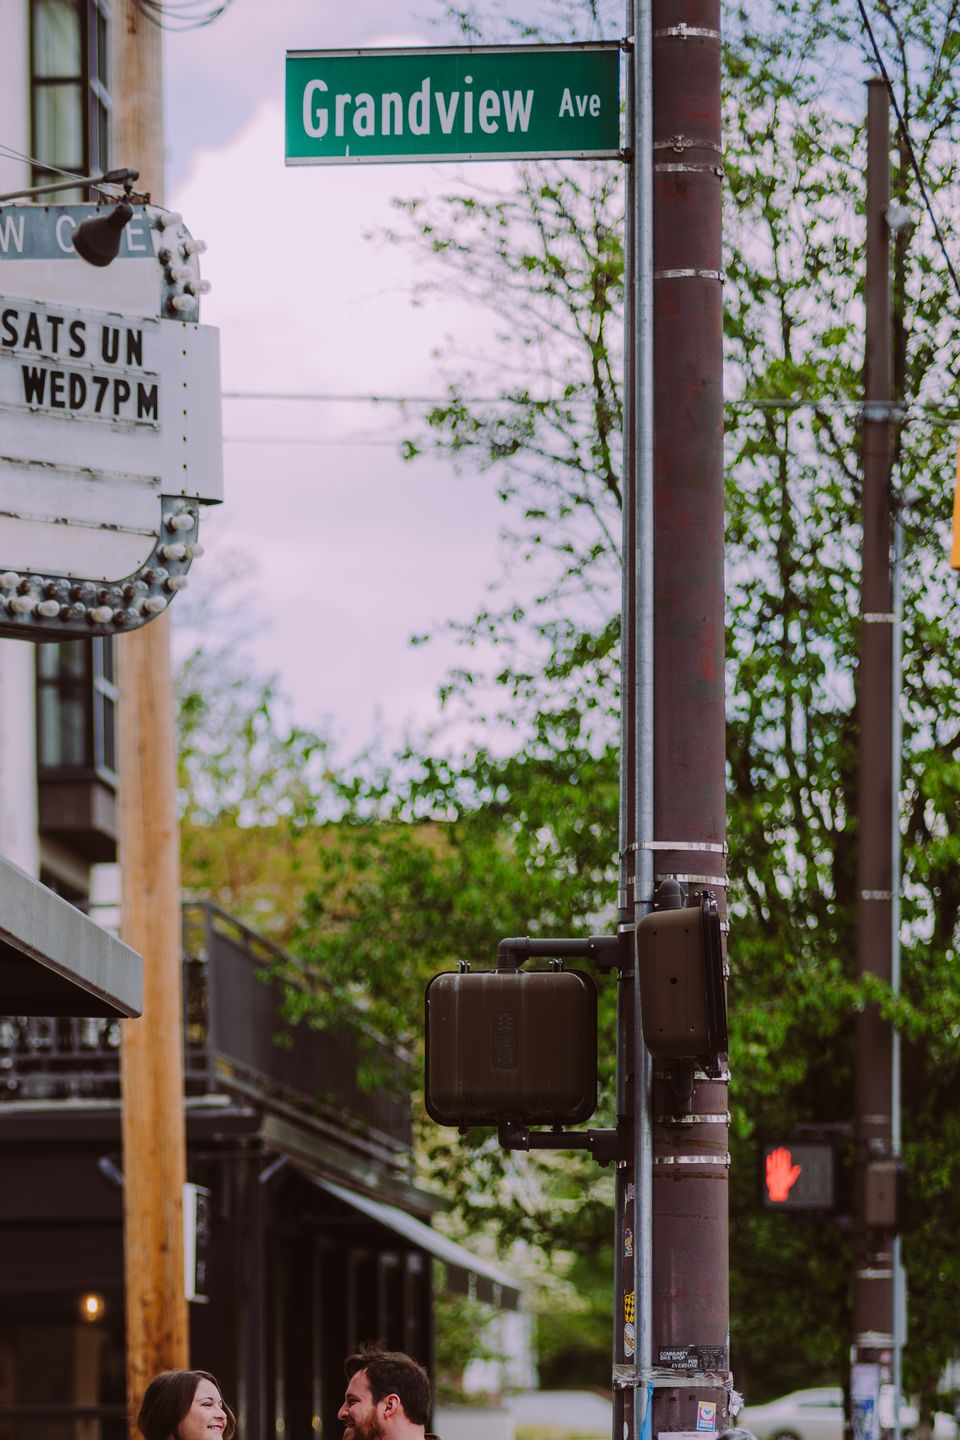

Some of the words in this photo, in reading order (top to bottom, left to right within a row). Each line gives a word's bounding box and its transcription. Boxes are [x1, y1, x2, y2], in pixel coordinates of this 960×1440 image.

[303, 75, 534, 138] Grandview
[558, 88, 601, 118] Ave
[56, 214, 146, 253] CE
